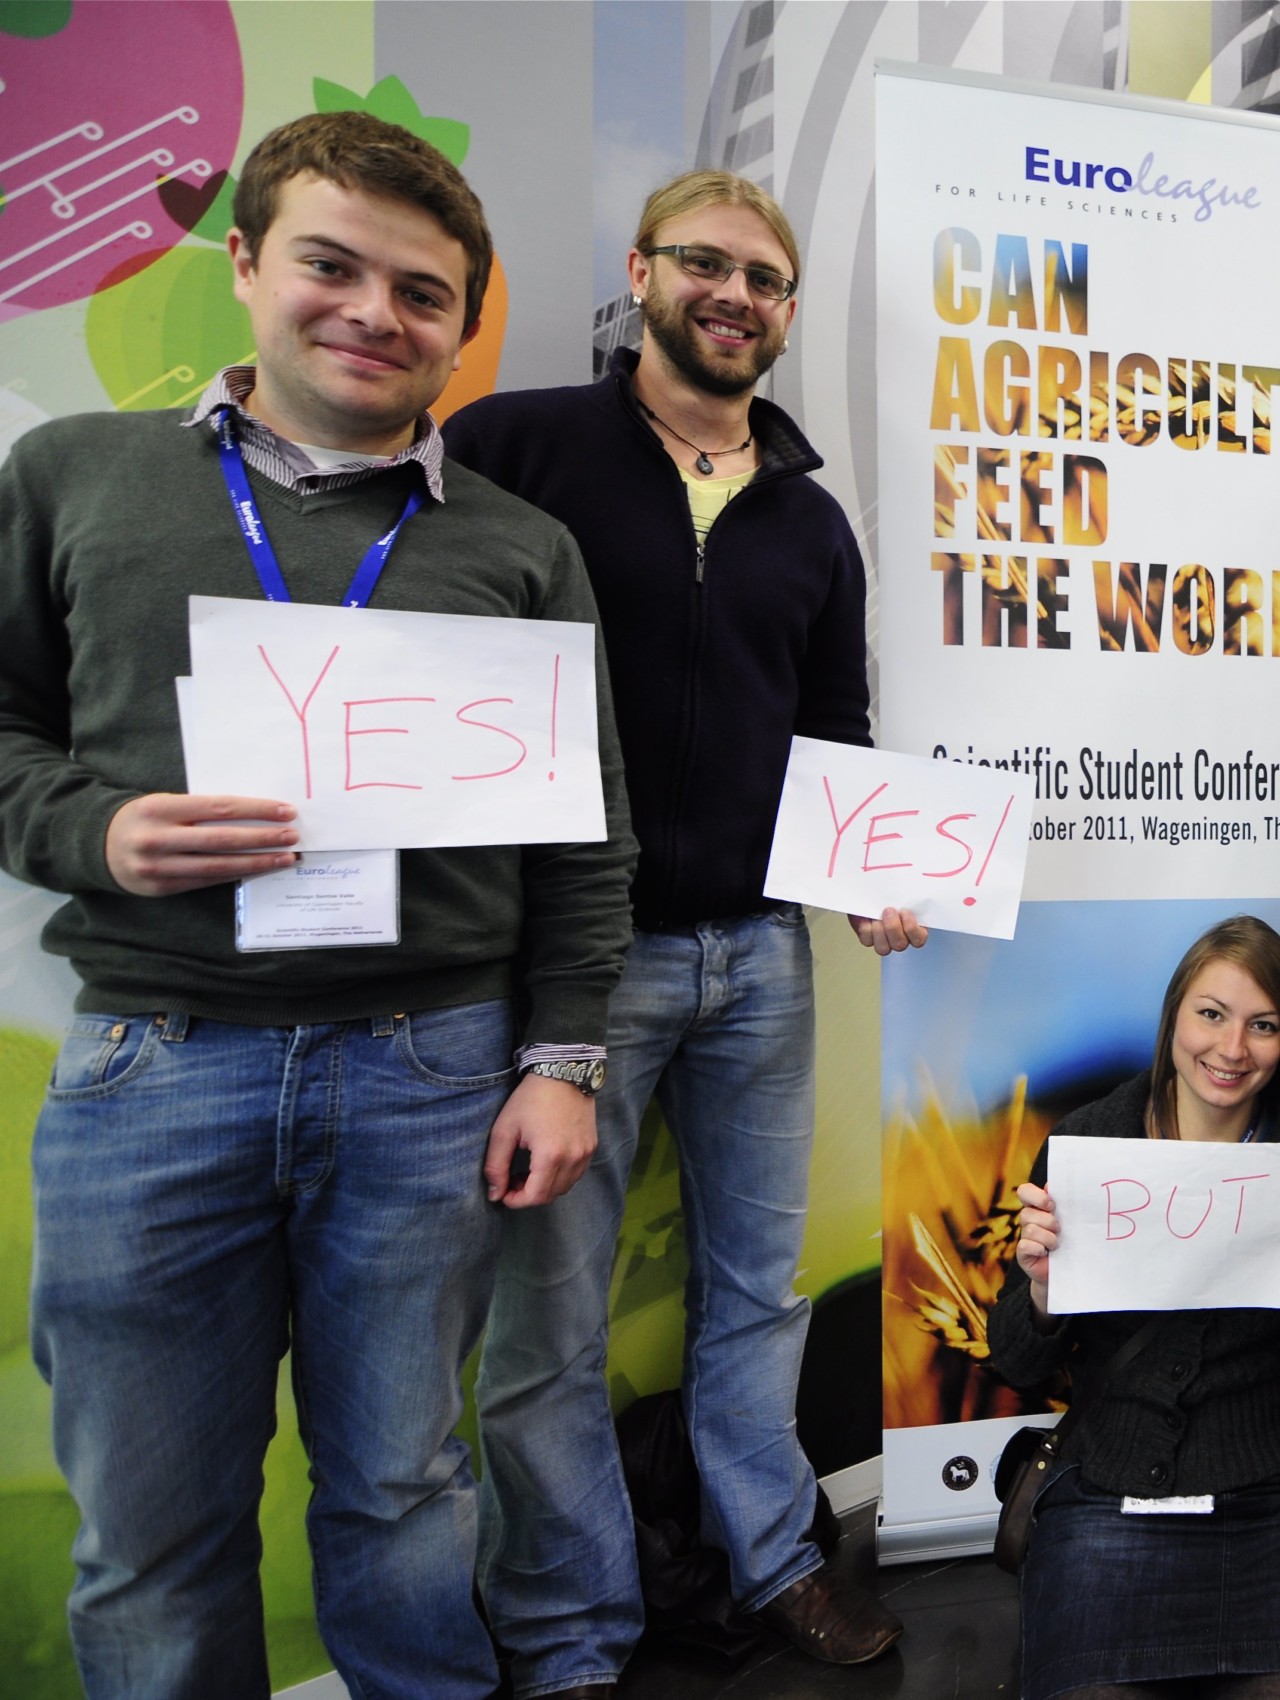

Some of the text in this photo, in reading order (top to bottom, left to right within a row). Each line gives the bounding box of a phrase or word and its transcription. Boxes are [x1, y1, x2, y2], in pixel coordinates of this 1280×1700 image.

[935, 185, 1177, 223] FOR LIFE SCIENCES
[1025, 146, 1261, 222] Euroleague
[932, 227, 1088, 336] CAN
[934, 445, 1109, 546] FEED
[931, 553, 1072, 650] THE
[257, 644, 560, 799] YES!
[1079, 747, 1183, 800] Student
[823, 776, 1014, 907] YES!
[1029, 816, 1077, 841] ober
[1083, 816, 1134, 844] 2011,
[1141, 816, 1257, 845] Wageningen,
[1101, 1174, 1270, 1240] BUT
